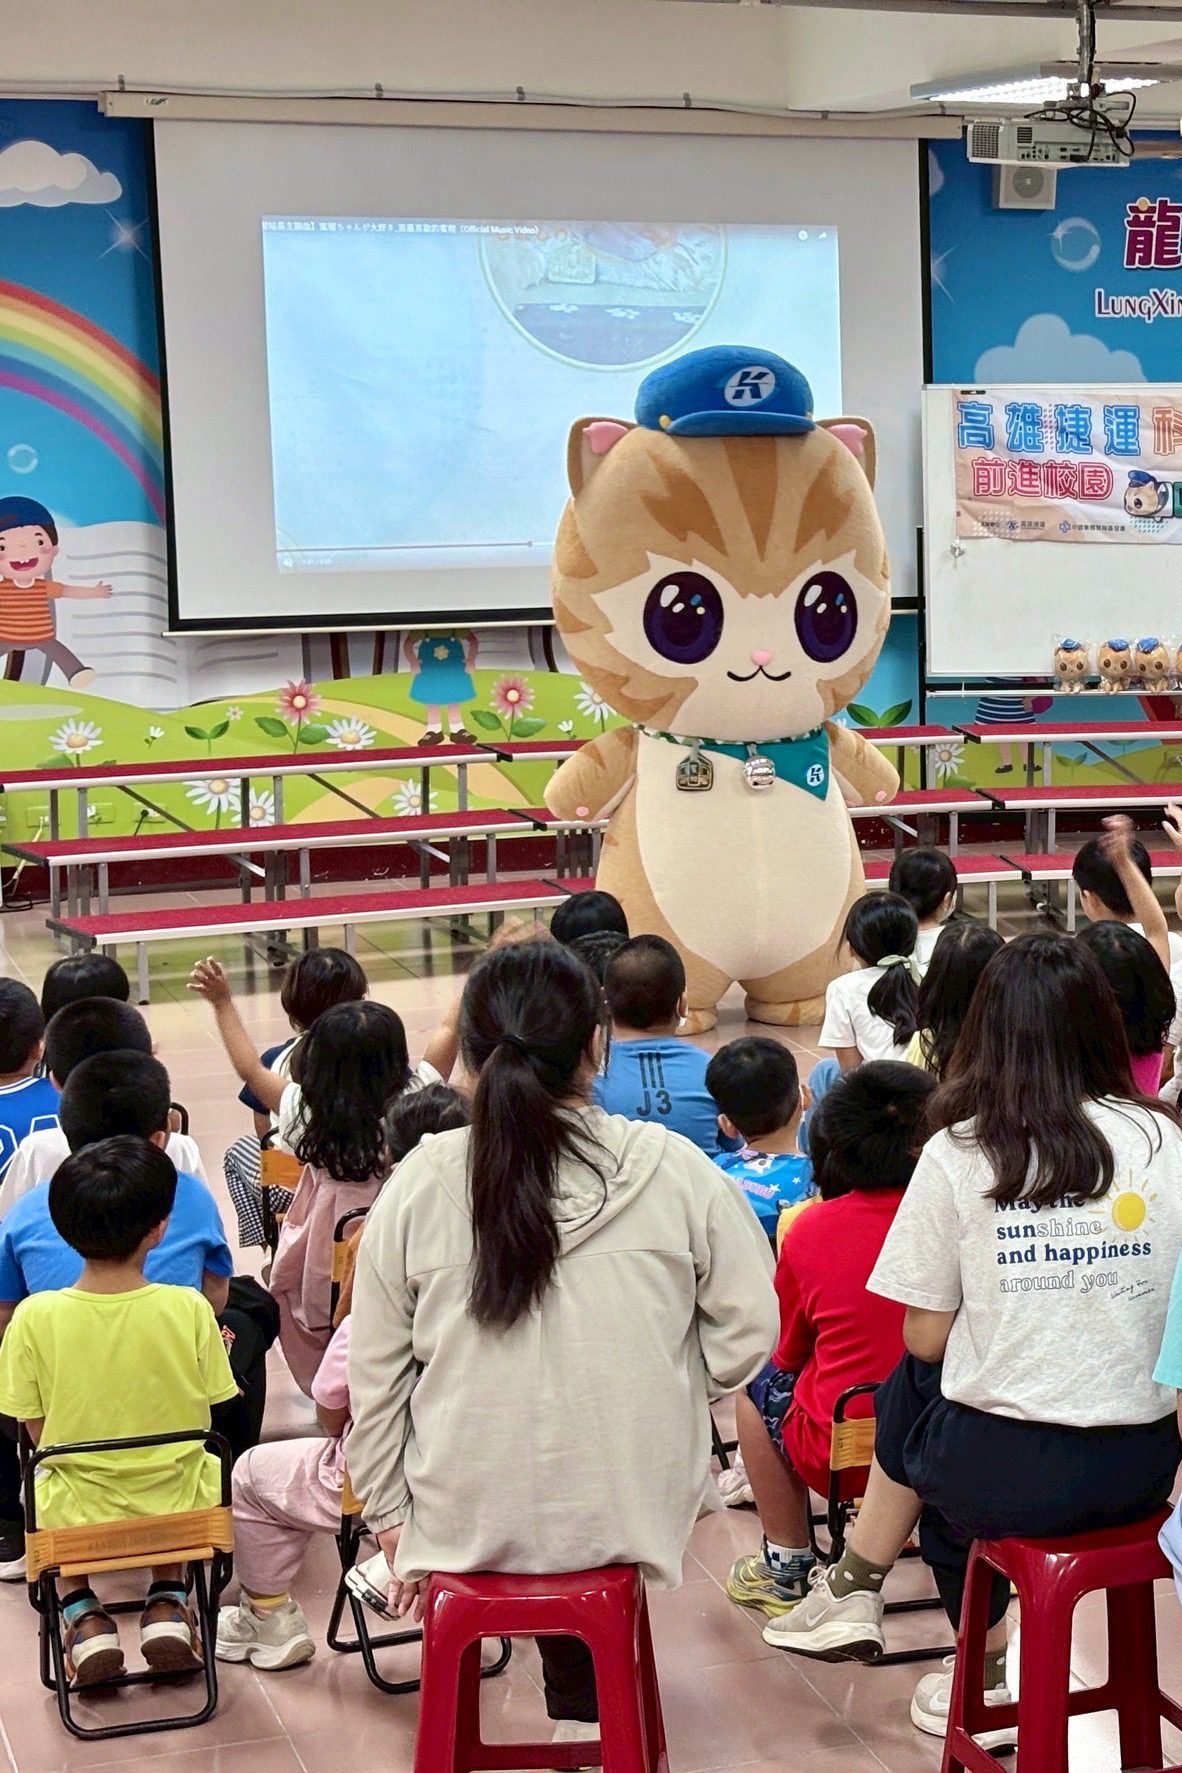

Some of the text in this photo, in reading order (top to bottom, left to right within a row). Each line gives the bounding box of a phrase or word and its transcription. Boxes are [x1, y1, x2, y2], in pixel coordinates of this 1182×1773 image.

[972, 457, 1114, 500] 前進校園
[636, 1090, 672, 1116] J3
[997, 1217, 1102, 1240] sunshine
[997, 1240, 1152, 1265] and happiness
[1000, 1269, 1118, 1293] around you
